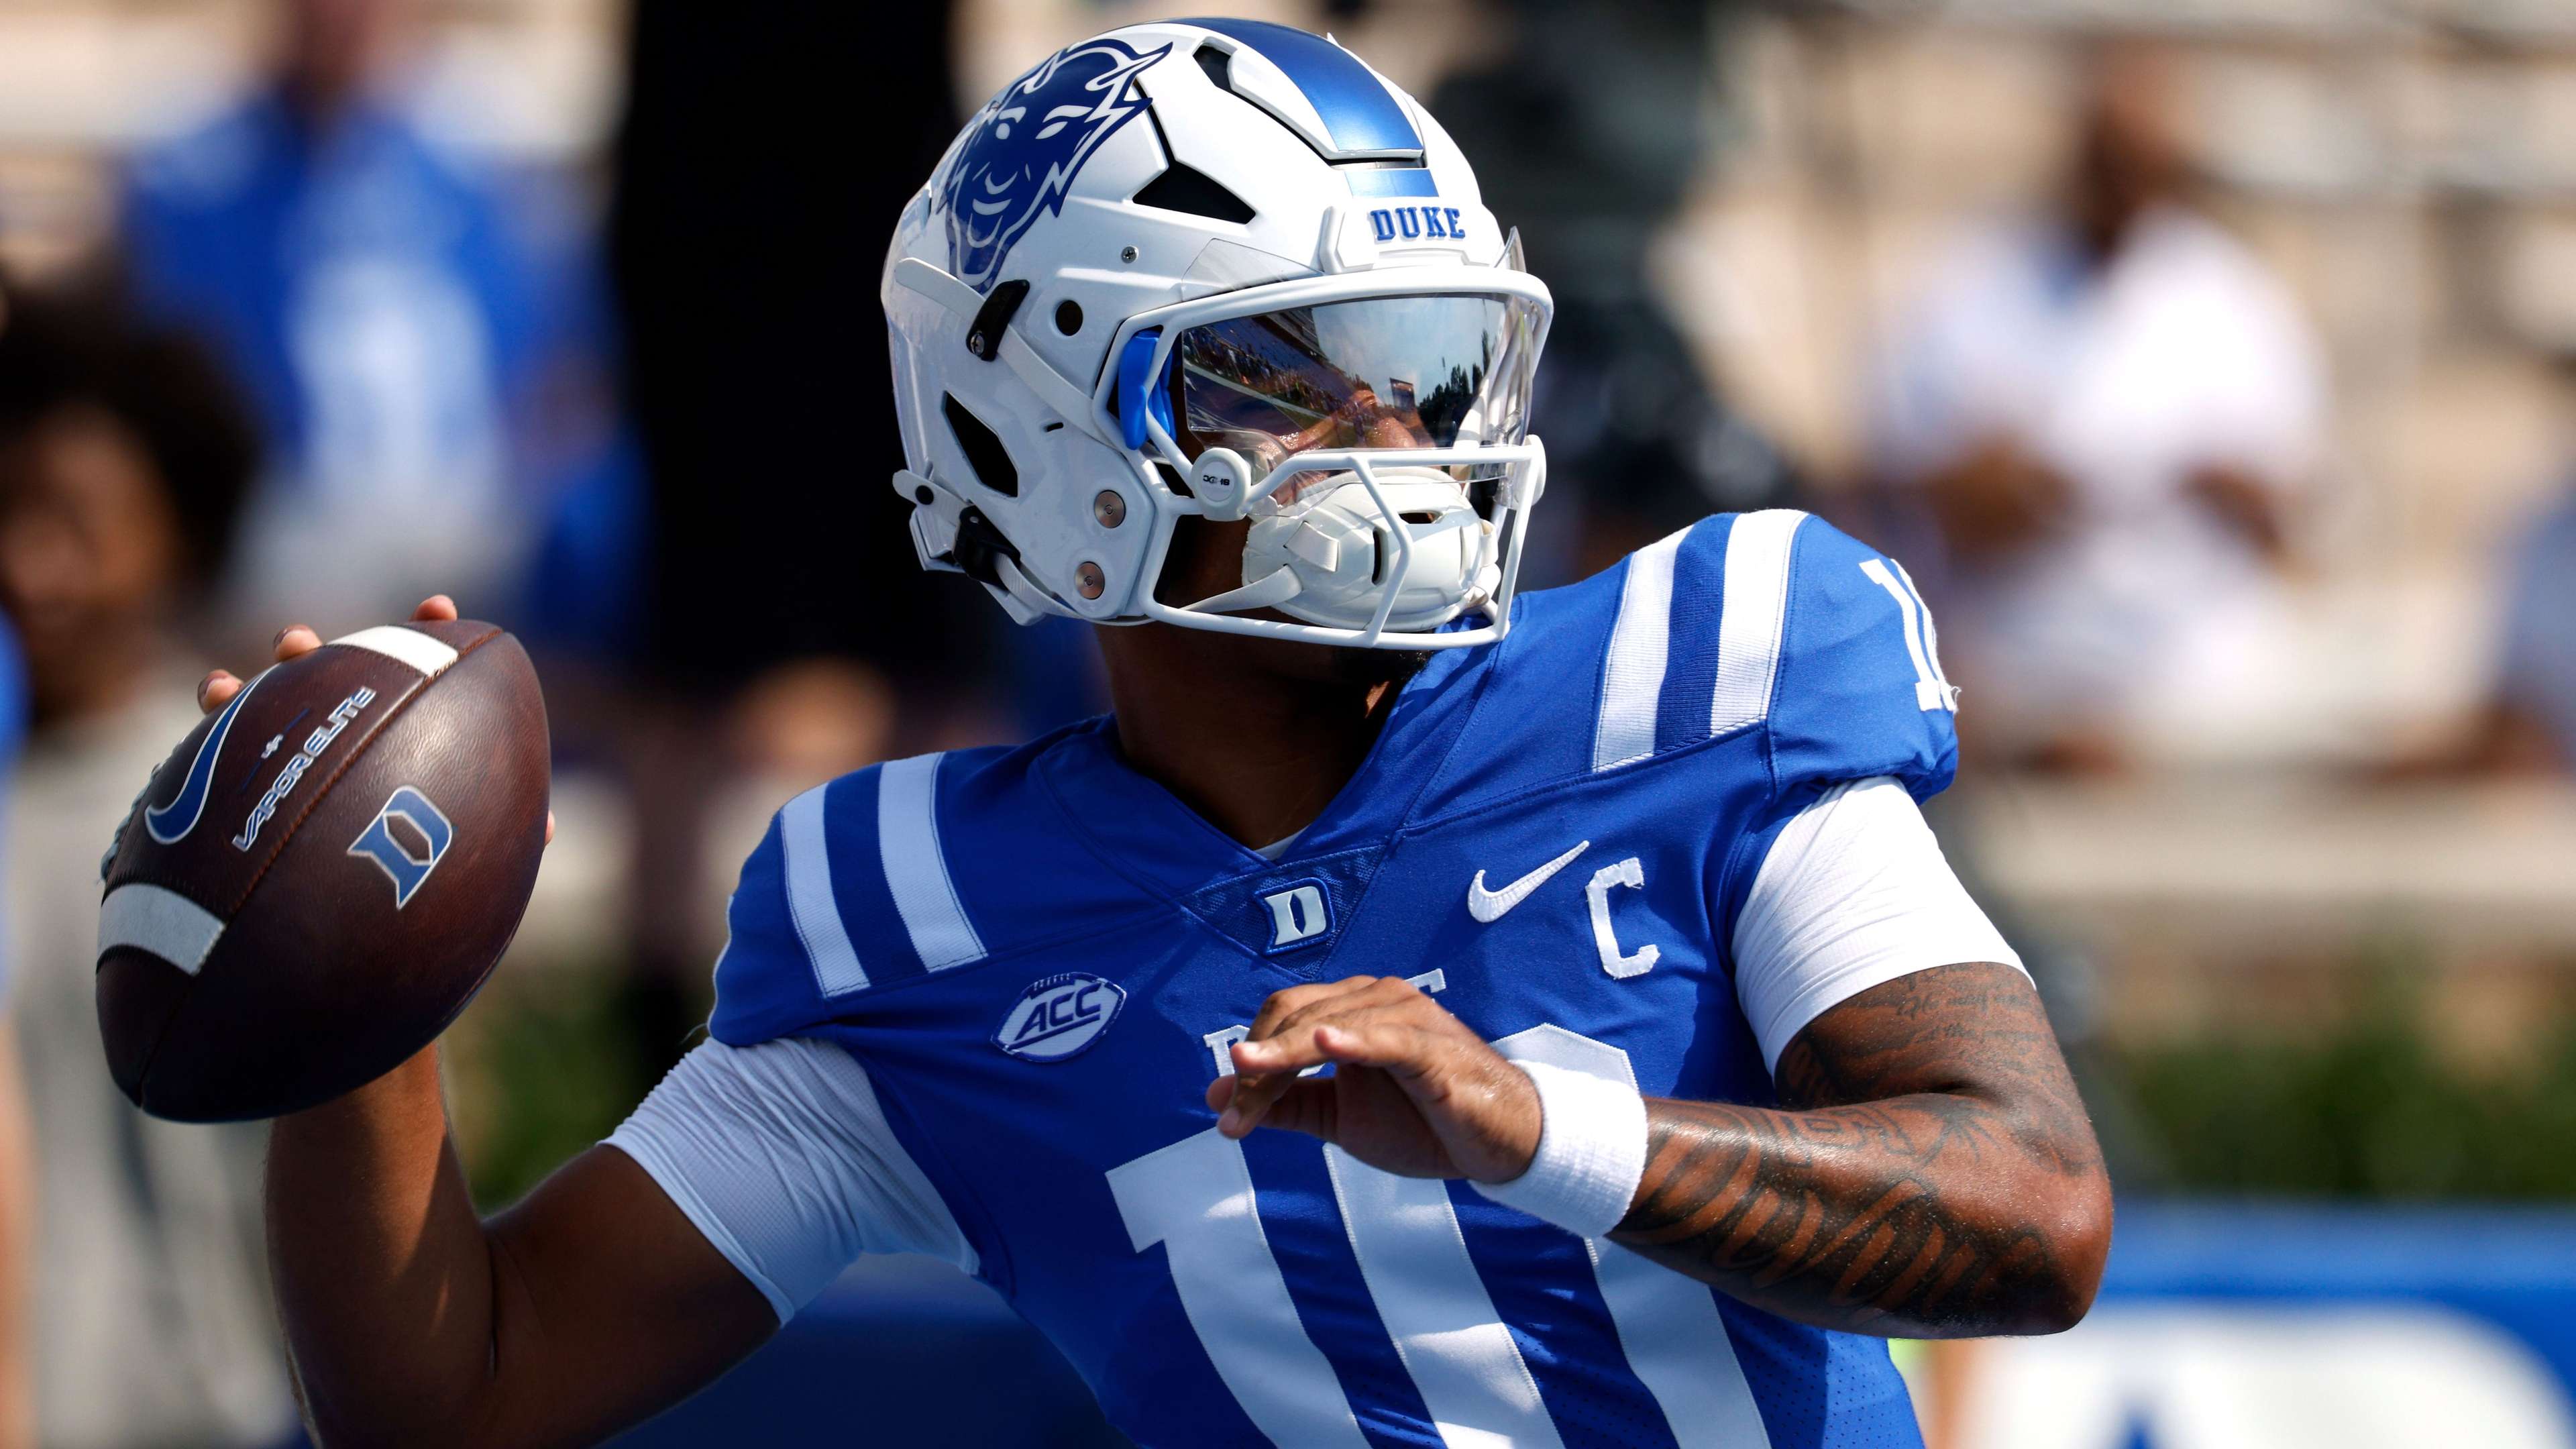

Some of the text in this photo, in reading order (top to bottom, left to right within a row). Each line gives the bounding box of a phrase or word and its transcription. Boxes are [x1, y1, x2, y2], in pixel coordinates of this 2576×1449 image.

[1370, 206, 1466, 241] DUKE
[346, 784, 453, 911] D
[1261, 882, 1330, 948] D
[1585, 857, 1662, 980] C
[1014, 982, 1102, 1042] ACC
